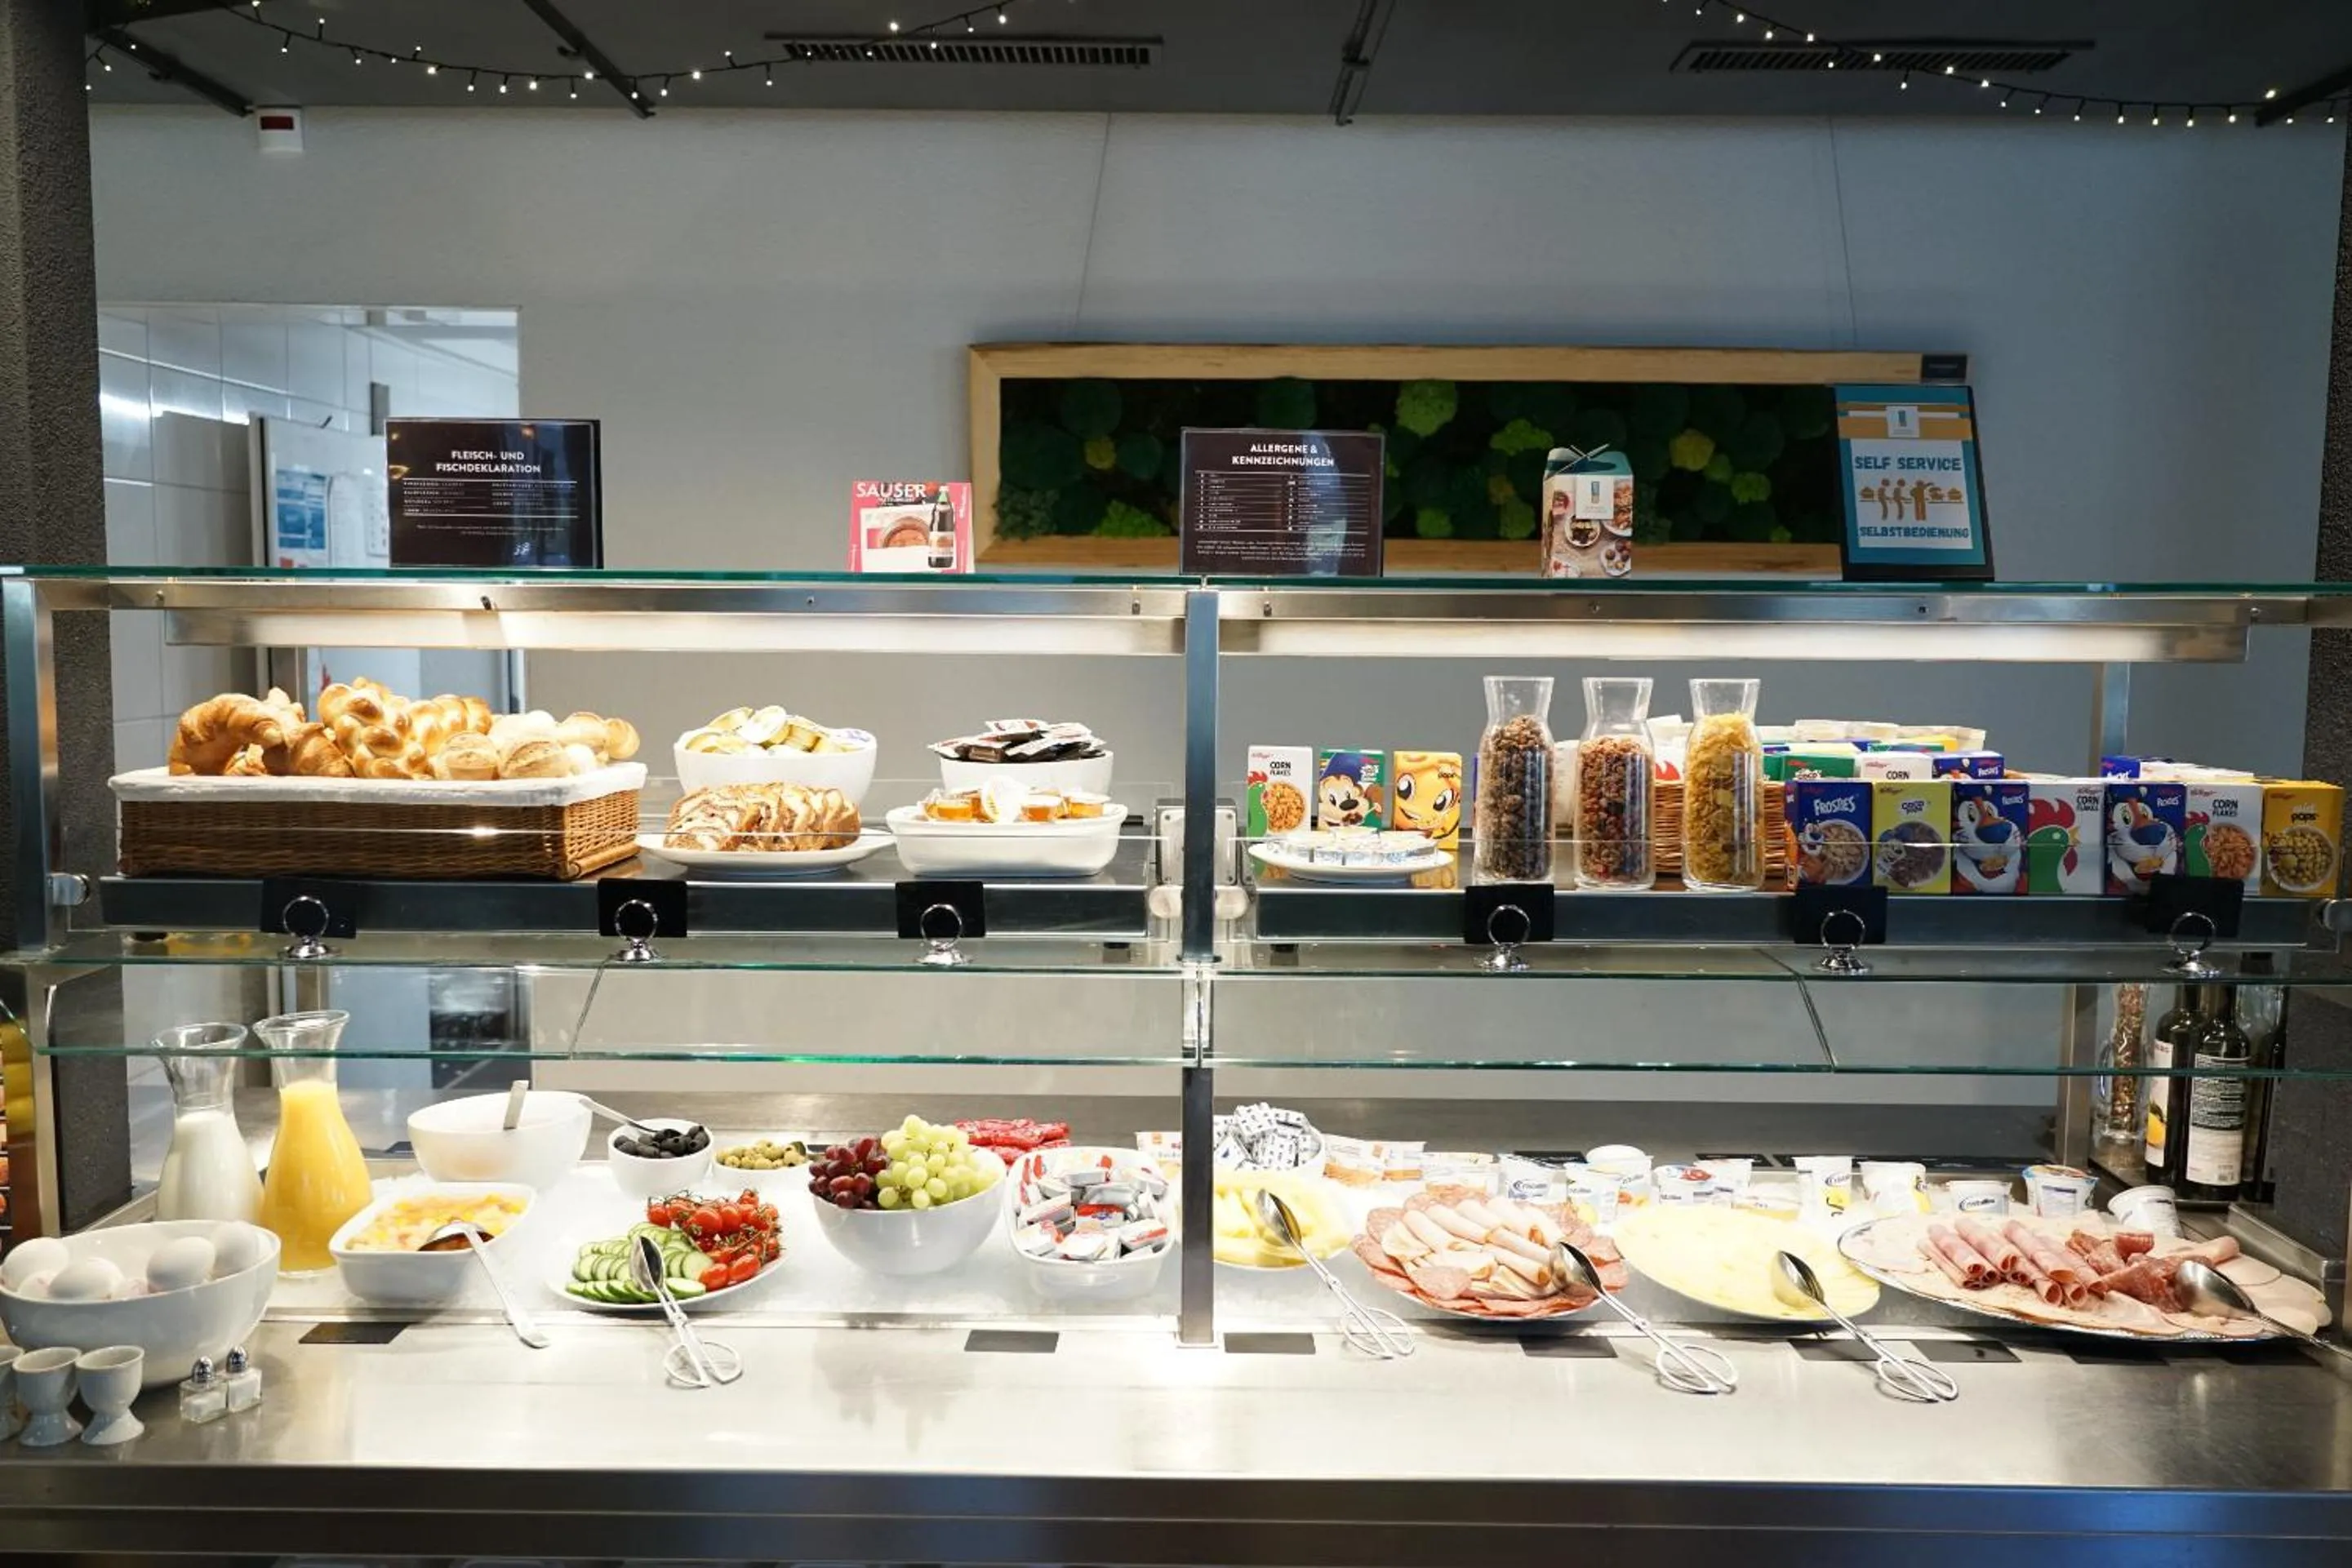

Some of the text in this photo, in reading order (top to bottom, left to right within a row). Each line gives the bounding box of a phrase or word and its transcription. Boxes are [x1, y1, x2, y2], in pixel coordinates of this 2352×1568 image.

[1250, 443, 1318, 454] ALLERGENE &
[451, 451, 525, 460] FLEISCH- UND
[1231, 455, 1335, 467] KENNZEICHNUNGEN
[1854, 455, 1962, 471] SELF SERVICE
[435, 463, 541, 473] FISCHDEKLARATION
[856, 482, 927, 498] SAUSER
[1859, 526, 1970, 539] SELBSTBEDIENUNG
[1269, 761, 1292, 769] CORN
[1886, 771, 1910, 780] CORN
[2076, 795, 2099, 804] CORN
[2212, 799, 2239, 809] CORN
